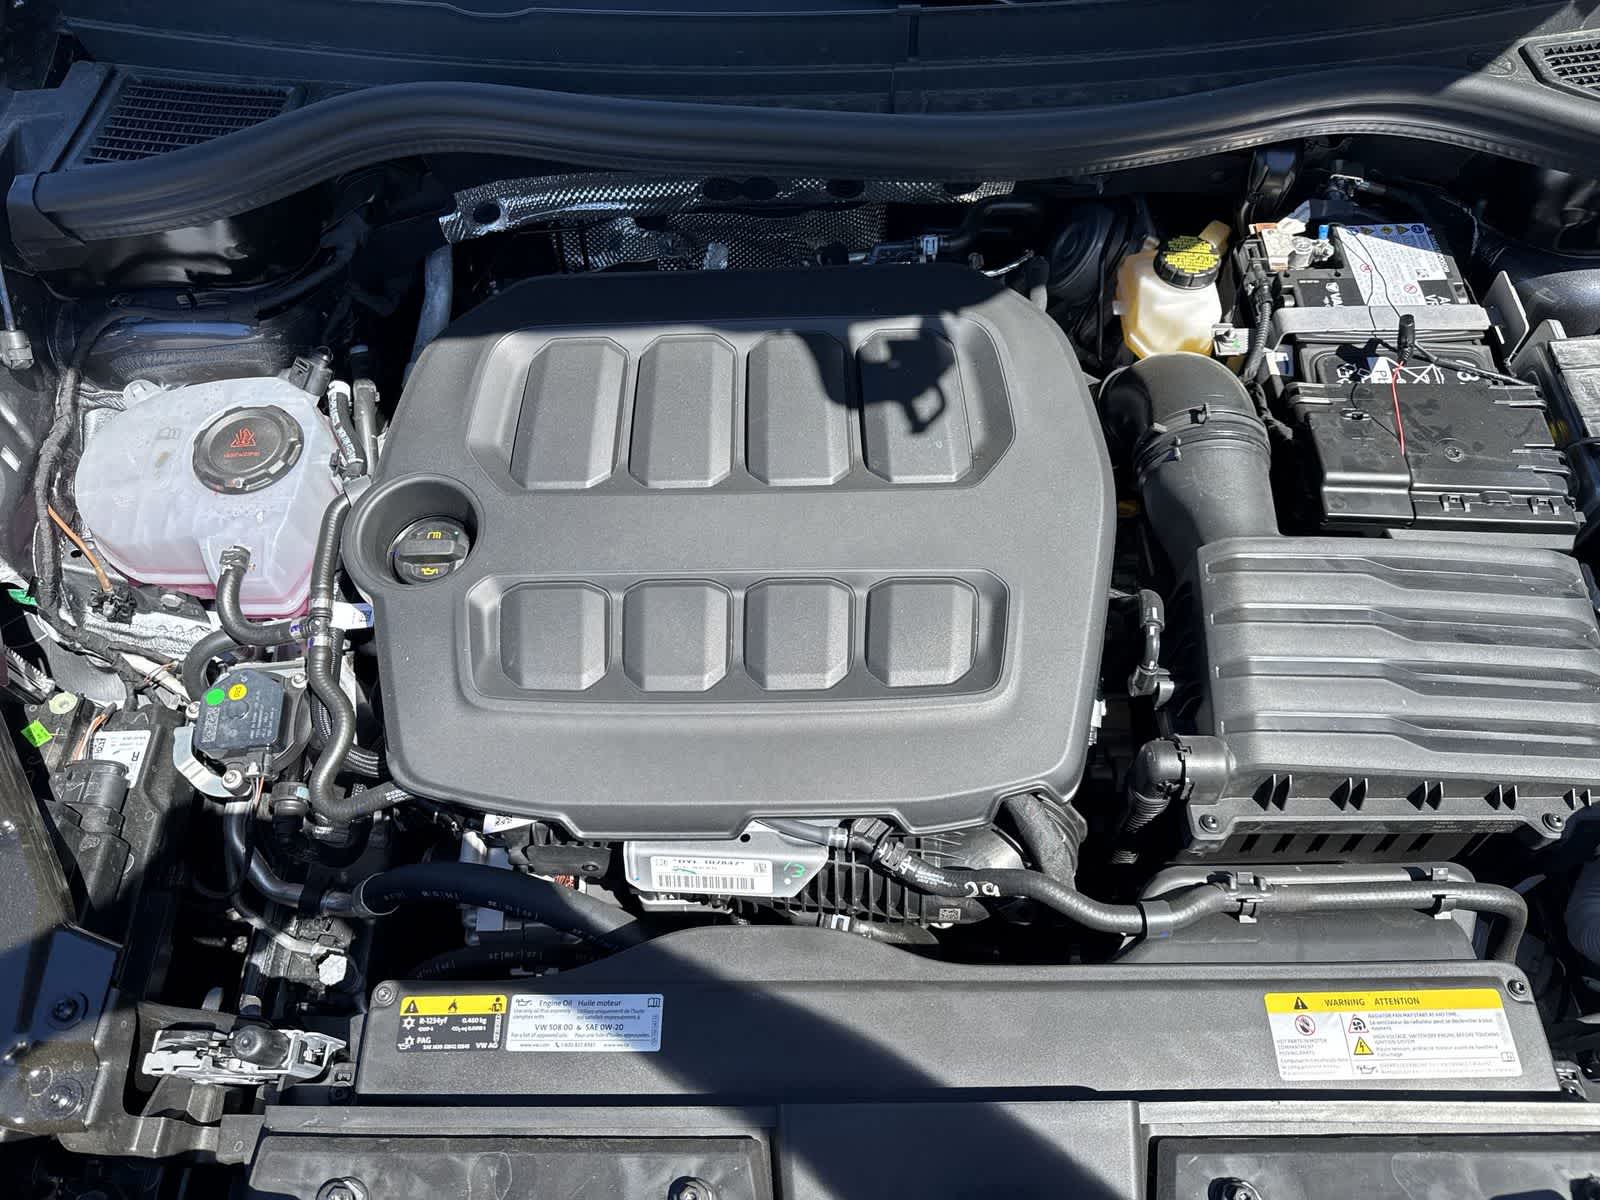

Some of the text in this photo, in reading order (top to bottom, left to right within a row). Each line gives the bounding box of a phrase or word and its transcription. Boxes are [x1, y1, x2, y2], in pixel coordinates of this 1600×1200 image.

[539, 999, 573, 1008] Engine Oil
[577, 999, 622, 1007] Huile moteur
[1374, 997, 1420, 1006] ATTENTION
[563, 1023, 574, 1031] 00
[585, 1023, 599, 1031] SAE
[600, 1023, 625, 1031] 0W-20
